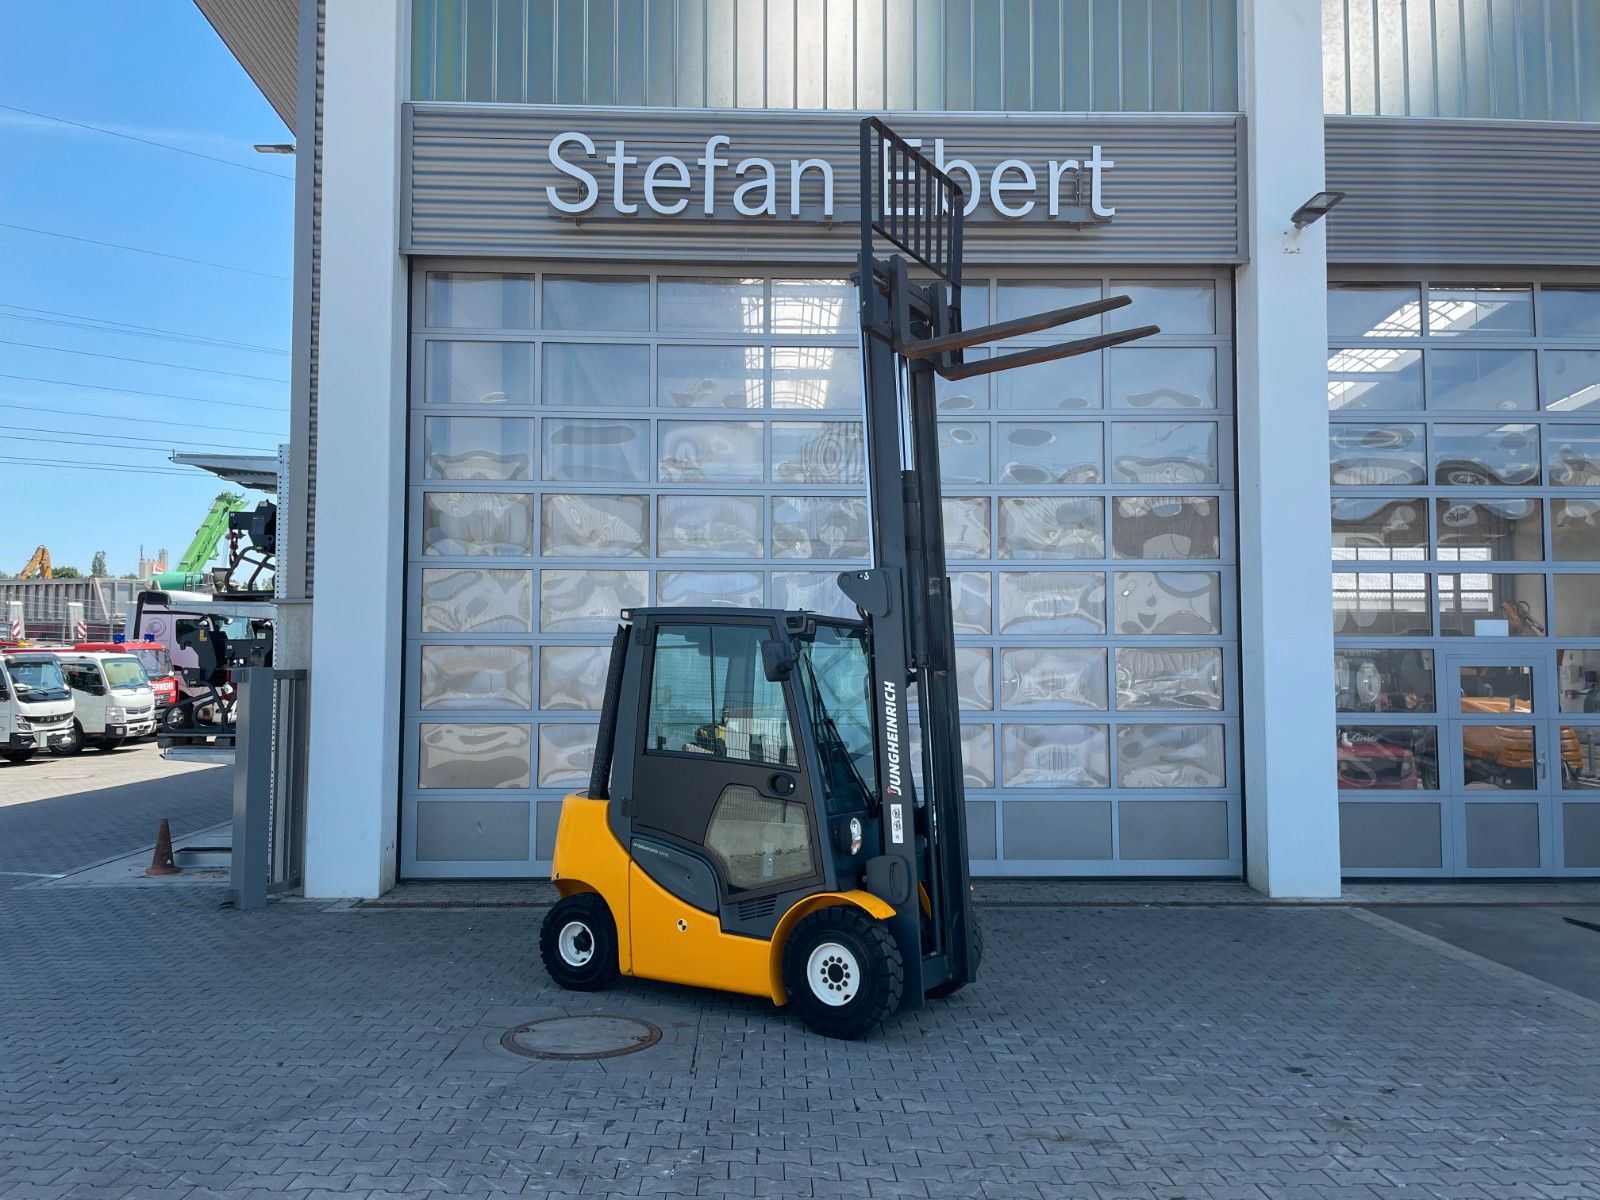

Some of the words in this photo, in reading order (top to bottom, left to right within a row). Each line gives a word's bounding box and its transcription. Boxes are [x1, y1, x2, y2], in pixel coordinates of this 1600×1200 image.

[545, 131, 835, 216] Stefan
[883, 138, 1116, 218] Ebert
[883, 680, 902, 796] JUNGHEINRICH
